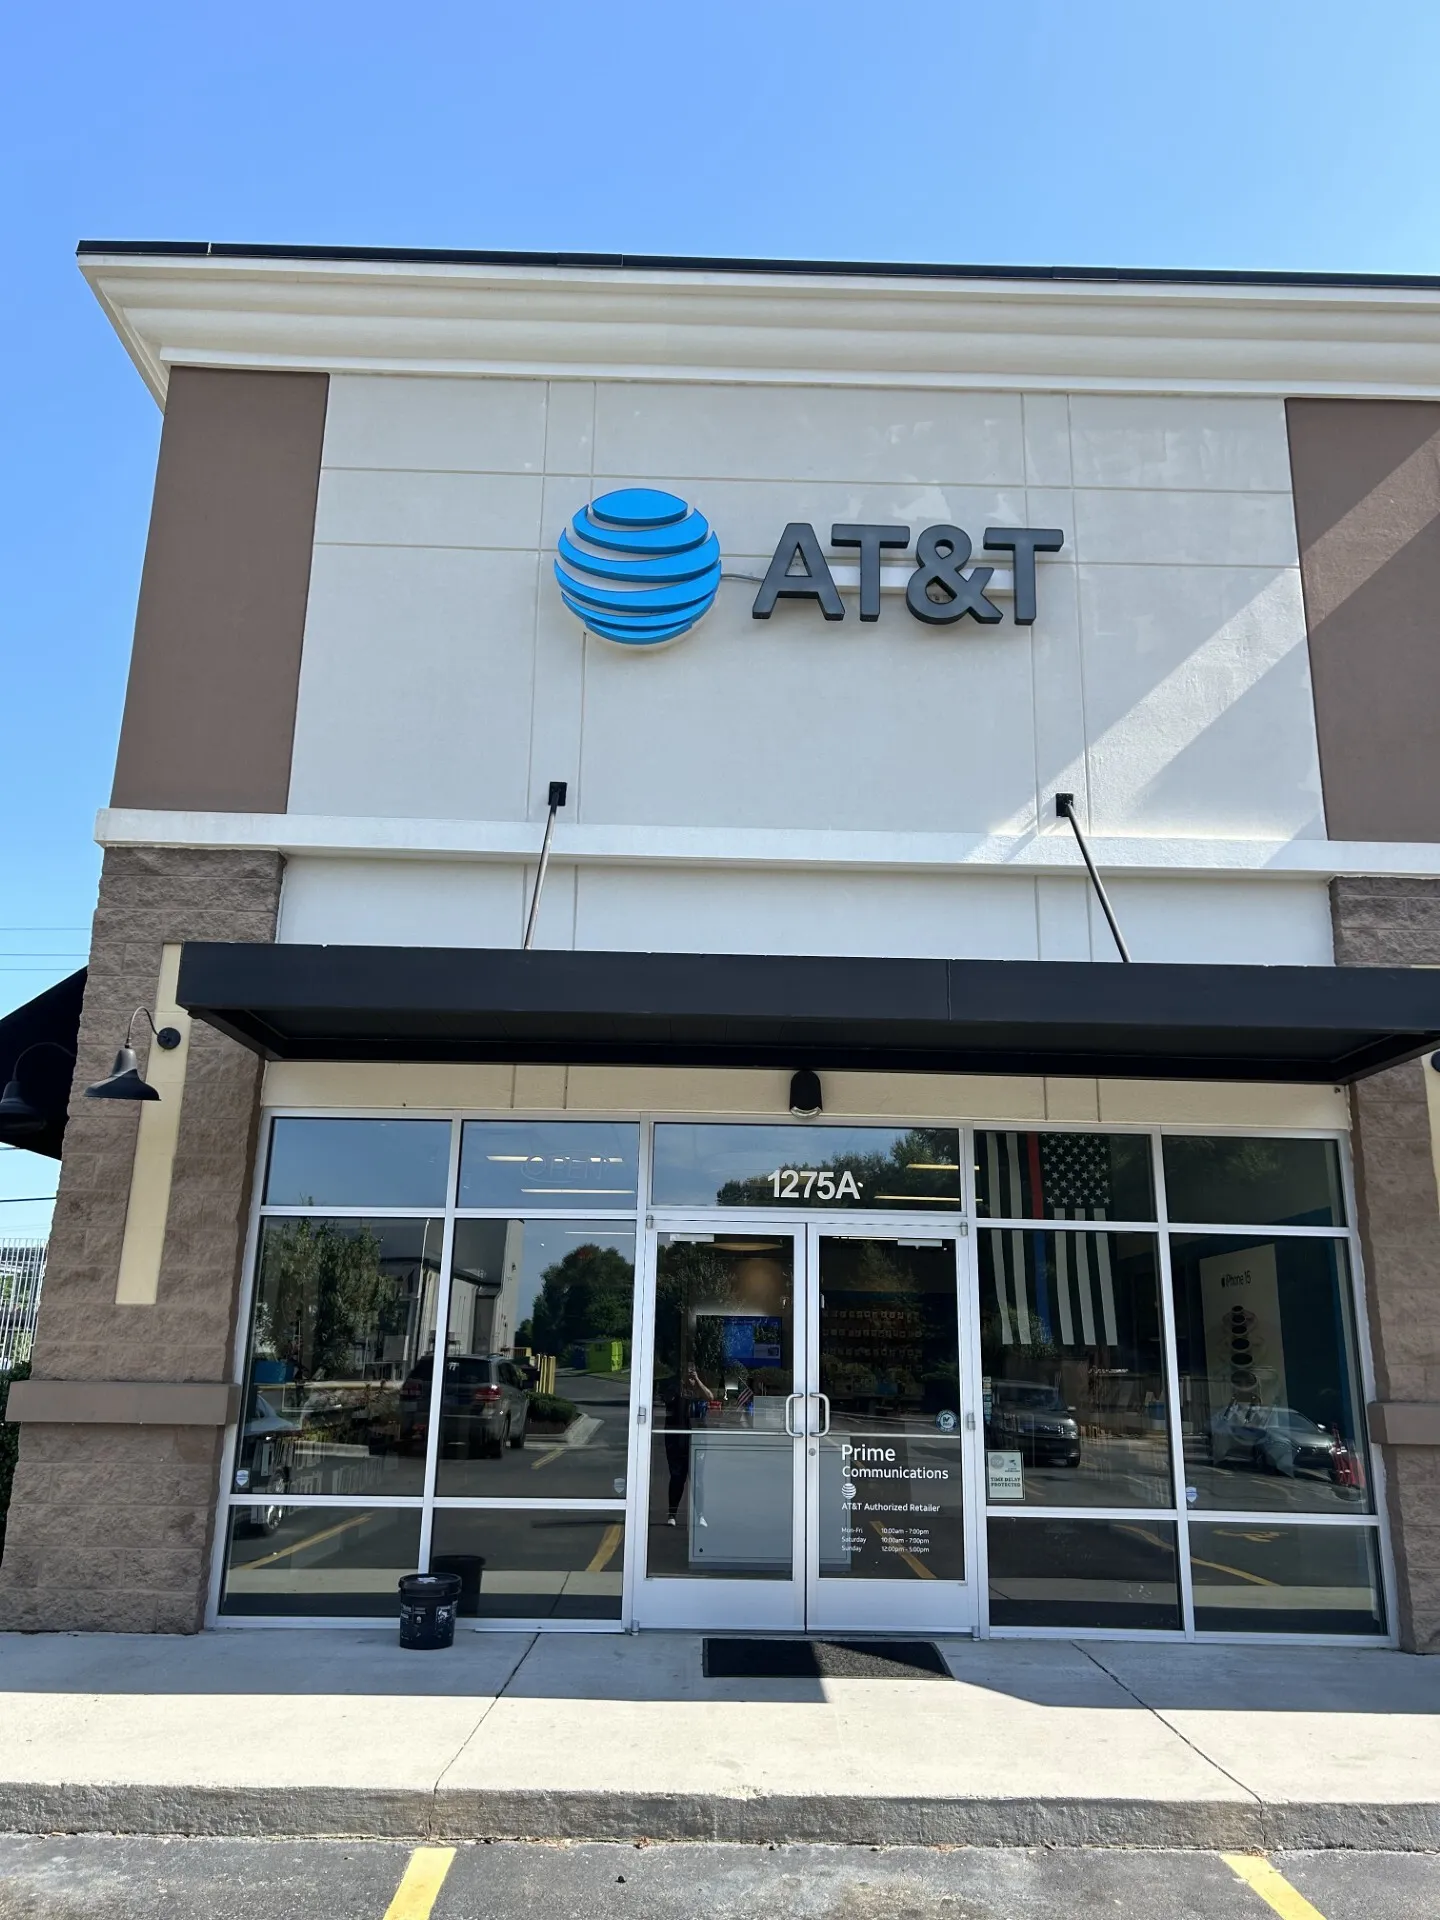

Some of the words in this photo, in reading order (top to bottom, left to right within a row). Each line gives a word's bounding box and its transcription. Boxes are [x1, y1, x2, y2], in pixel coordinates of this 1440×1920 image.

[752, 522, 1064, 626] AT&T
[767, 1169, 861, 1200] 1275A
[841, 1443, 896, 1461] Prime
[842, 1465, 949, 1480] Communications
[841, 1502, 863, 1511] AT&T
[864, 1503, 908, 1512] Authorized
[910, 1504, 941, 1512] Retailer
[841, 1527, 863, 1535] Mon-Fri
[881, 1527, 905, 1535] 10:00am
[841, 1536, 867, 1544] Saturday
[841, 1545, 863, 1553] Sunday
